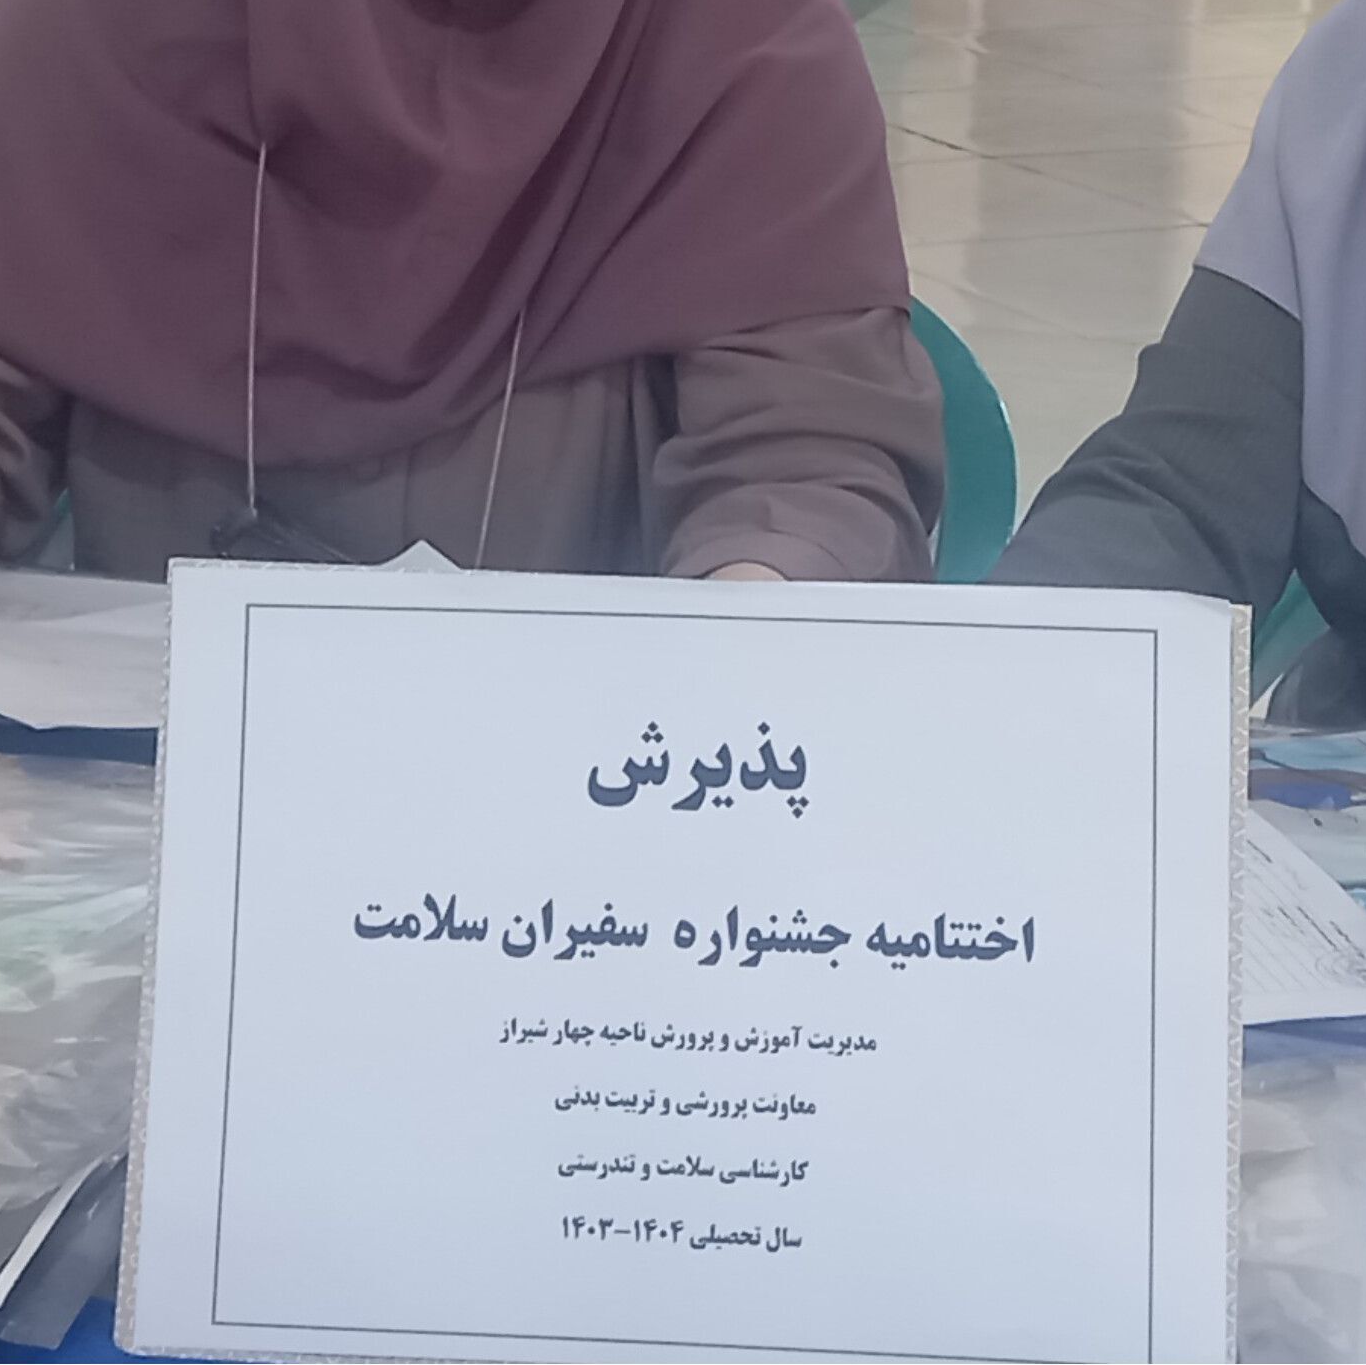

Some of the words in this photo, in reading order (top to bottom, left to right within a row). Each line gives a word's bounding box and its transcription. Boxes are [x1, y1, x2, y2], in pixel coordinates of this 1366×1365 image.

[587, 721, 810, 819] پذیرش
[354, 892, 489, 942] سلامت
[501, 898, 649, 961] سفیران
[673, 904, 852, 969] جشنواره
[866, 912, 1035, 970] اختتامیه
[499, 1016, 549, 1045] شیراز
[552, 1018, 595, 1048] چهار
[599, 1021, 647, 1047] ناحیه
[650, 1023, 715, 1052] پرورش
[718, 1032, 730, 1053] و
[734, 1025, 803, 1054] آموزش
[807, 1032, 877, 1057] مدیریت
[554, 1085, 600, 1112] بدنی
[604, 1089, 656, 1116] تربیت
[659, 1097, 671, 1116] و
[675, 1091, 749, 1120] پرورشی
[752, 1092, 816, 1121] معاونت
[558, 1153, 636, 1180] تندرستی
[640, 1162, 651, 1181] و
[655, 1154, 715, 1177] سلامت
[719, 1158, 809, 1188] کارشناسی
[689, 1223, 762, 1250] تحصیلی
[765, 1226, 803, 1253] سال
